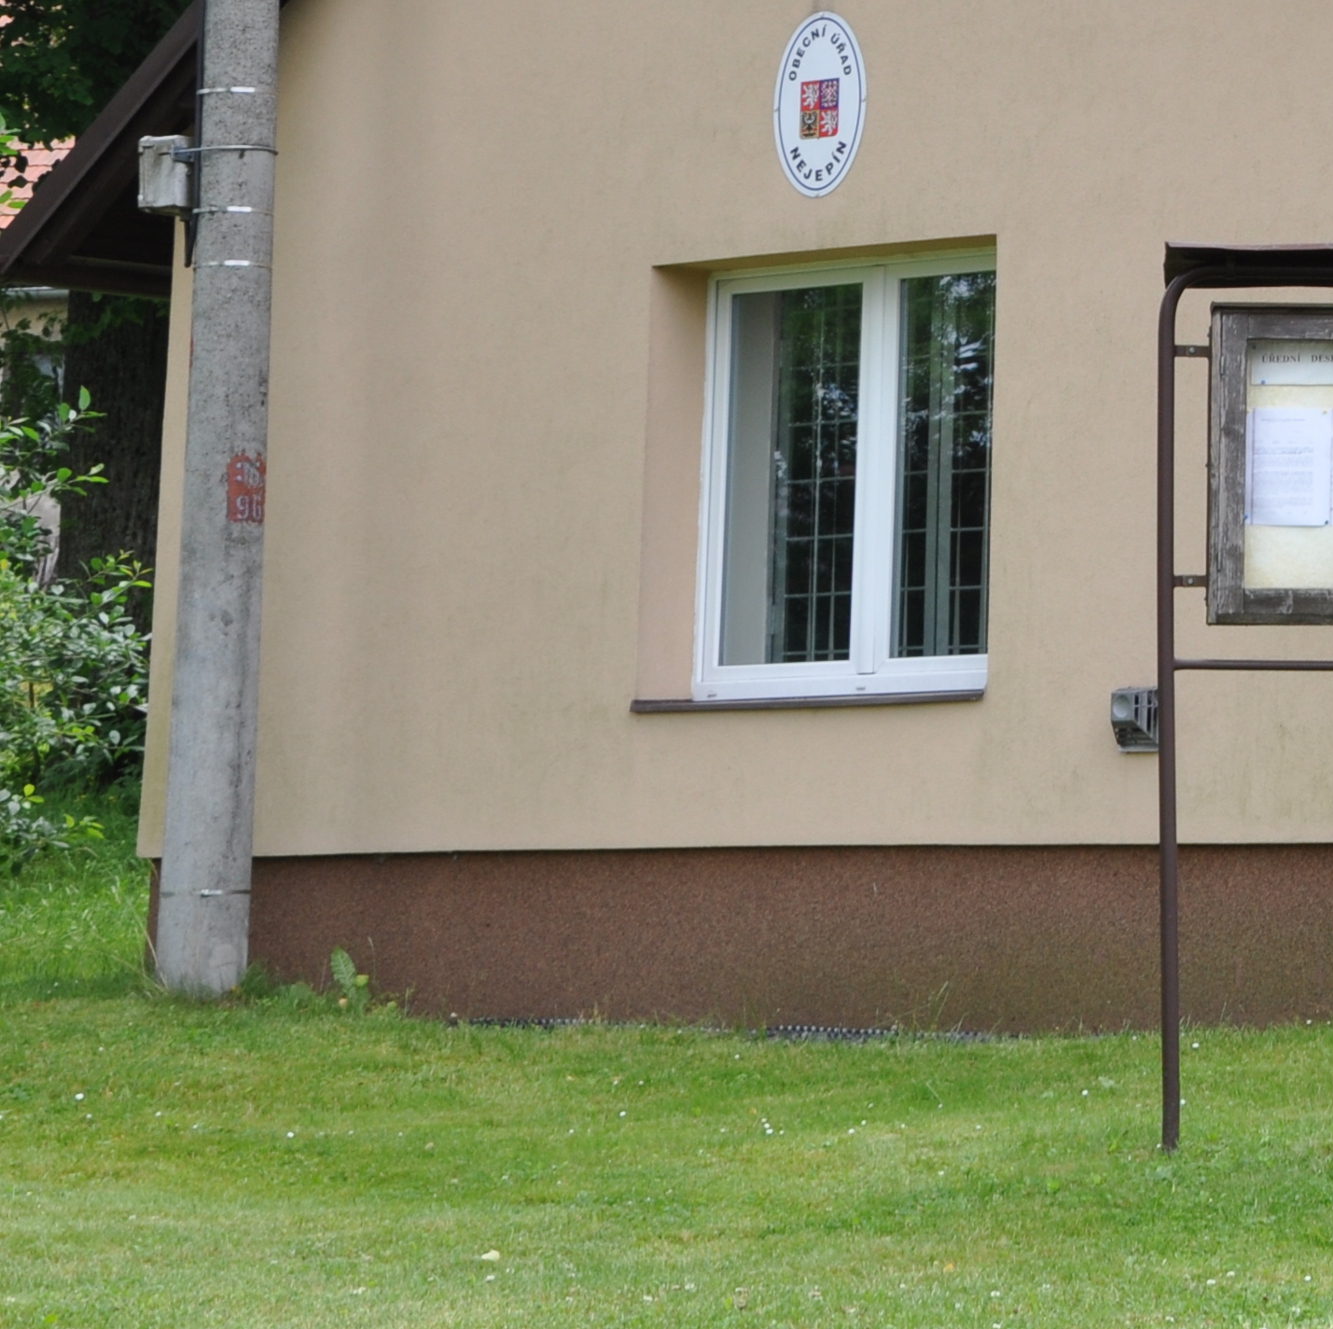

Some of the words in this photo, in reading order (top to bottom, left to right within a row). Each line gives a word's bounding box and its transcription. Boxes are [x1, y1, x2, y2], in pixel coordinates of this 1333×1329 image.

[788, 24, 827, 81] OBECNÍ
[830, 32, 852, 76] ÚŘAD
[790, 140, 847, 182] NEJEPÍN
[236, 494, 263, 520] 96
